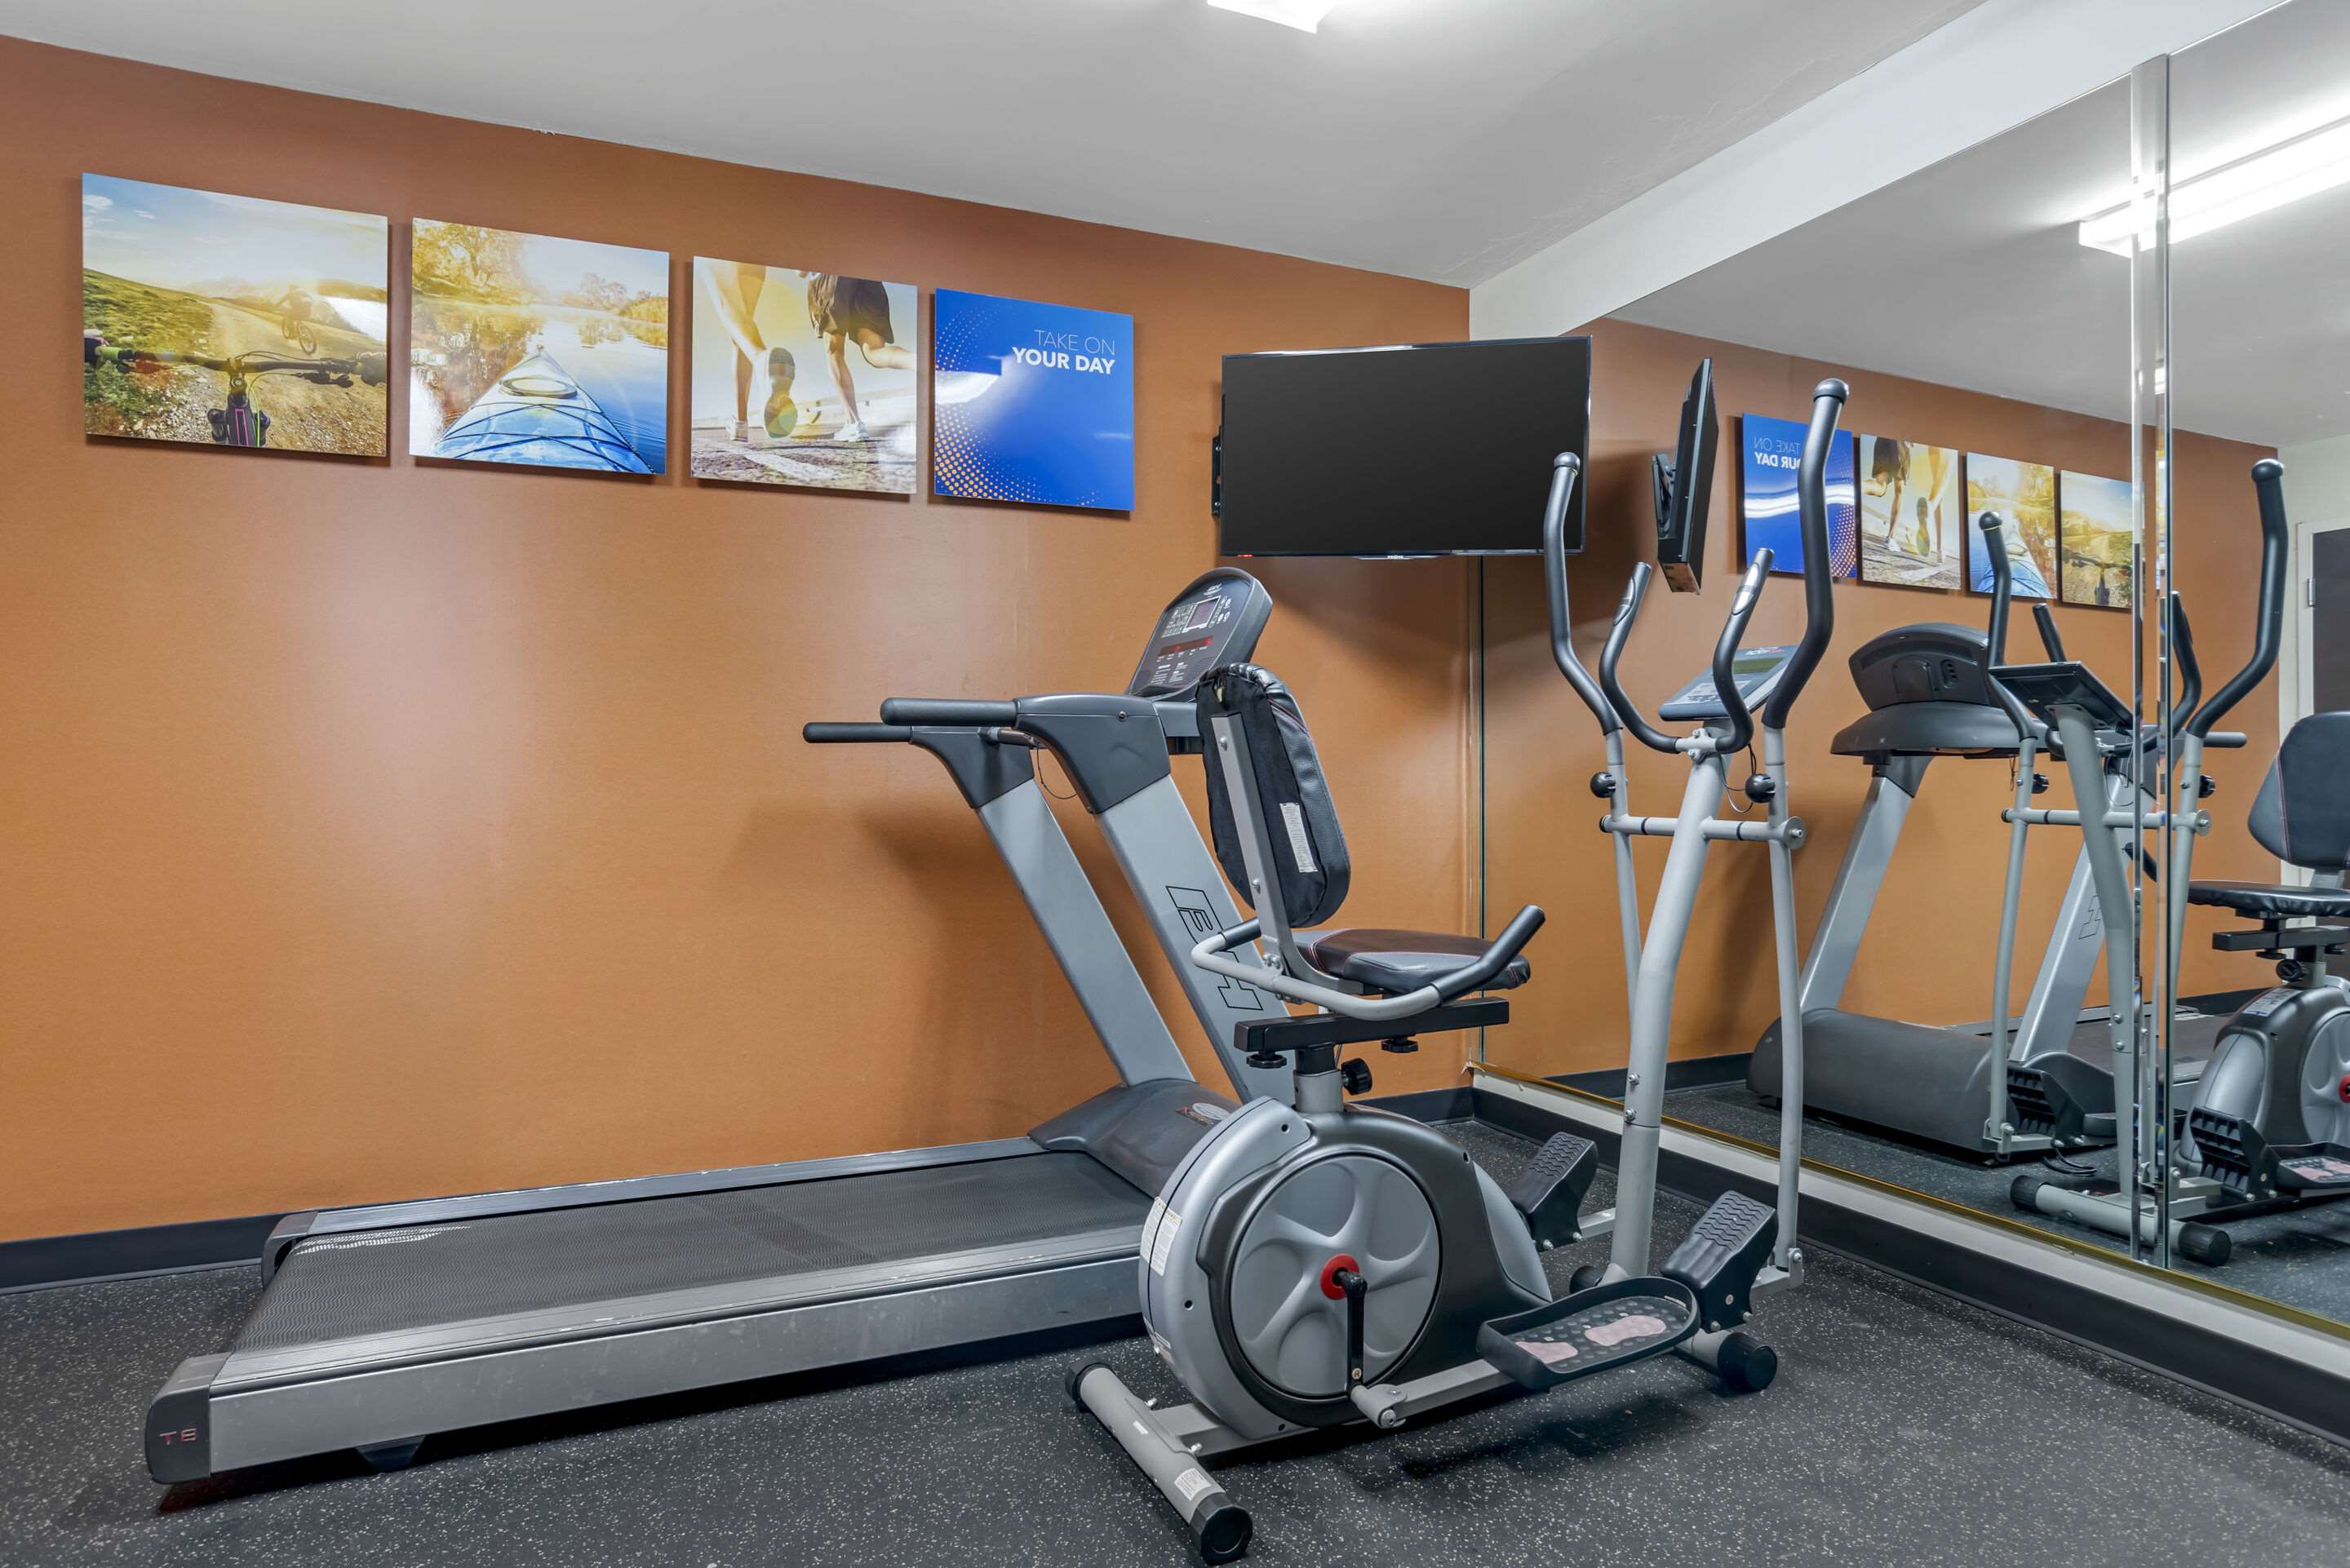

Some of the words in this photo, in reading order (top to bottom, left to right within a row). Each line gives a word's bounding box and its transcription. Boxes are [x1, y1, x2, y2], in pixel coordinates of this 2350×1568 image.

[1034, 329, 1080, 352] TAKE
[1084, 336, 1115, 356] ON
[1012, 346, 1070, 370] YOUR
[1075, 354, 1115, 374] DAY
